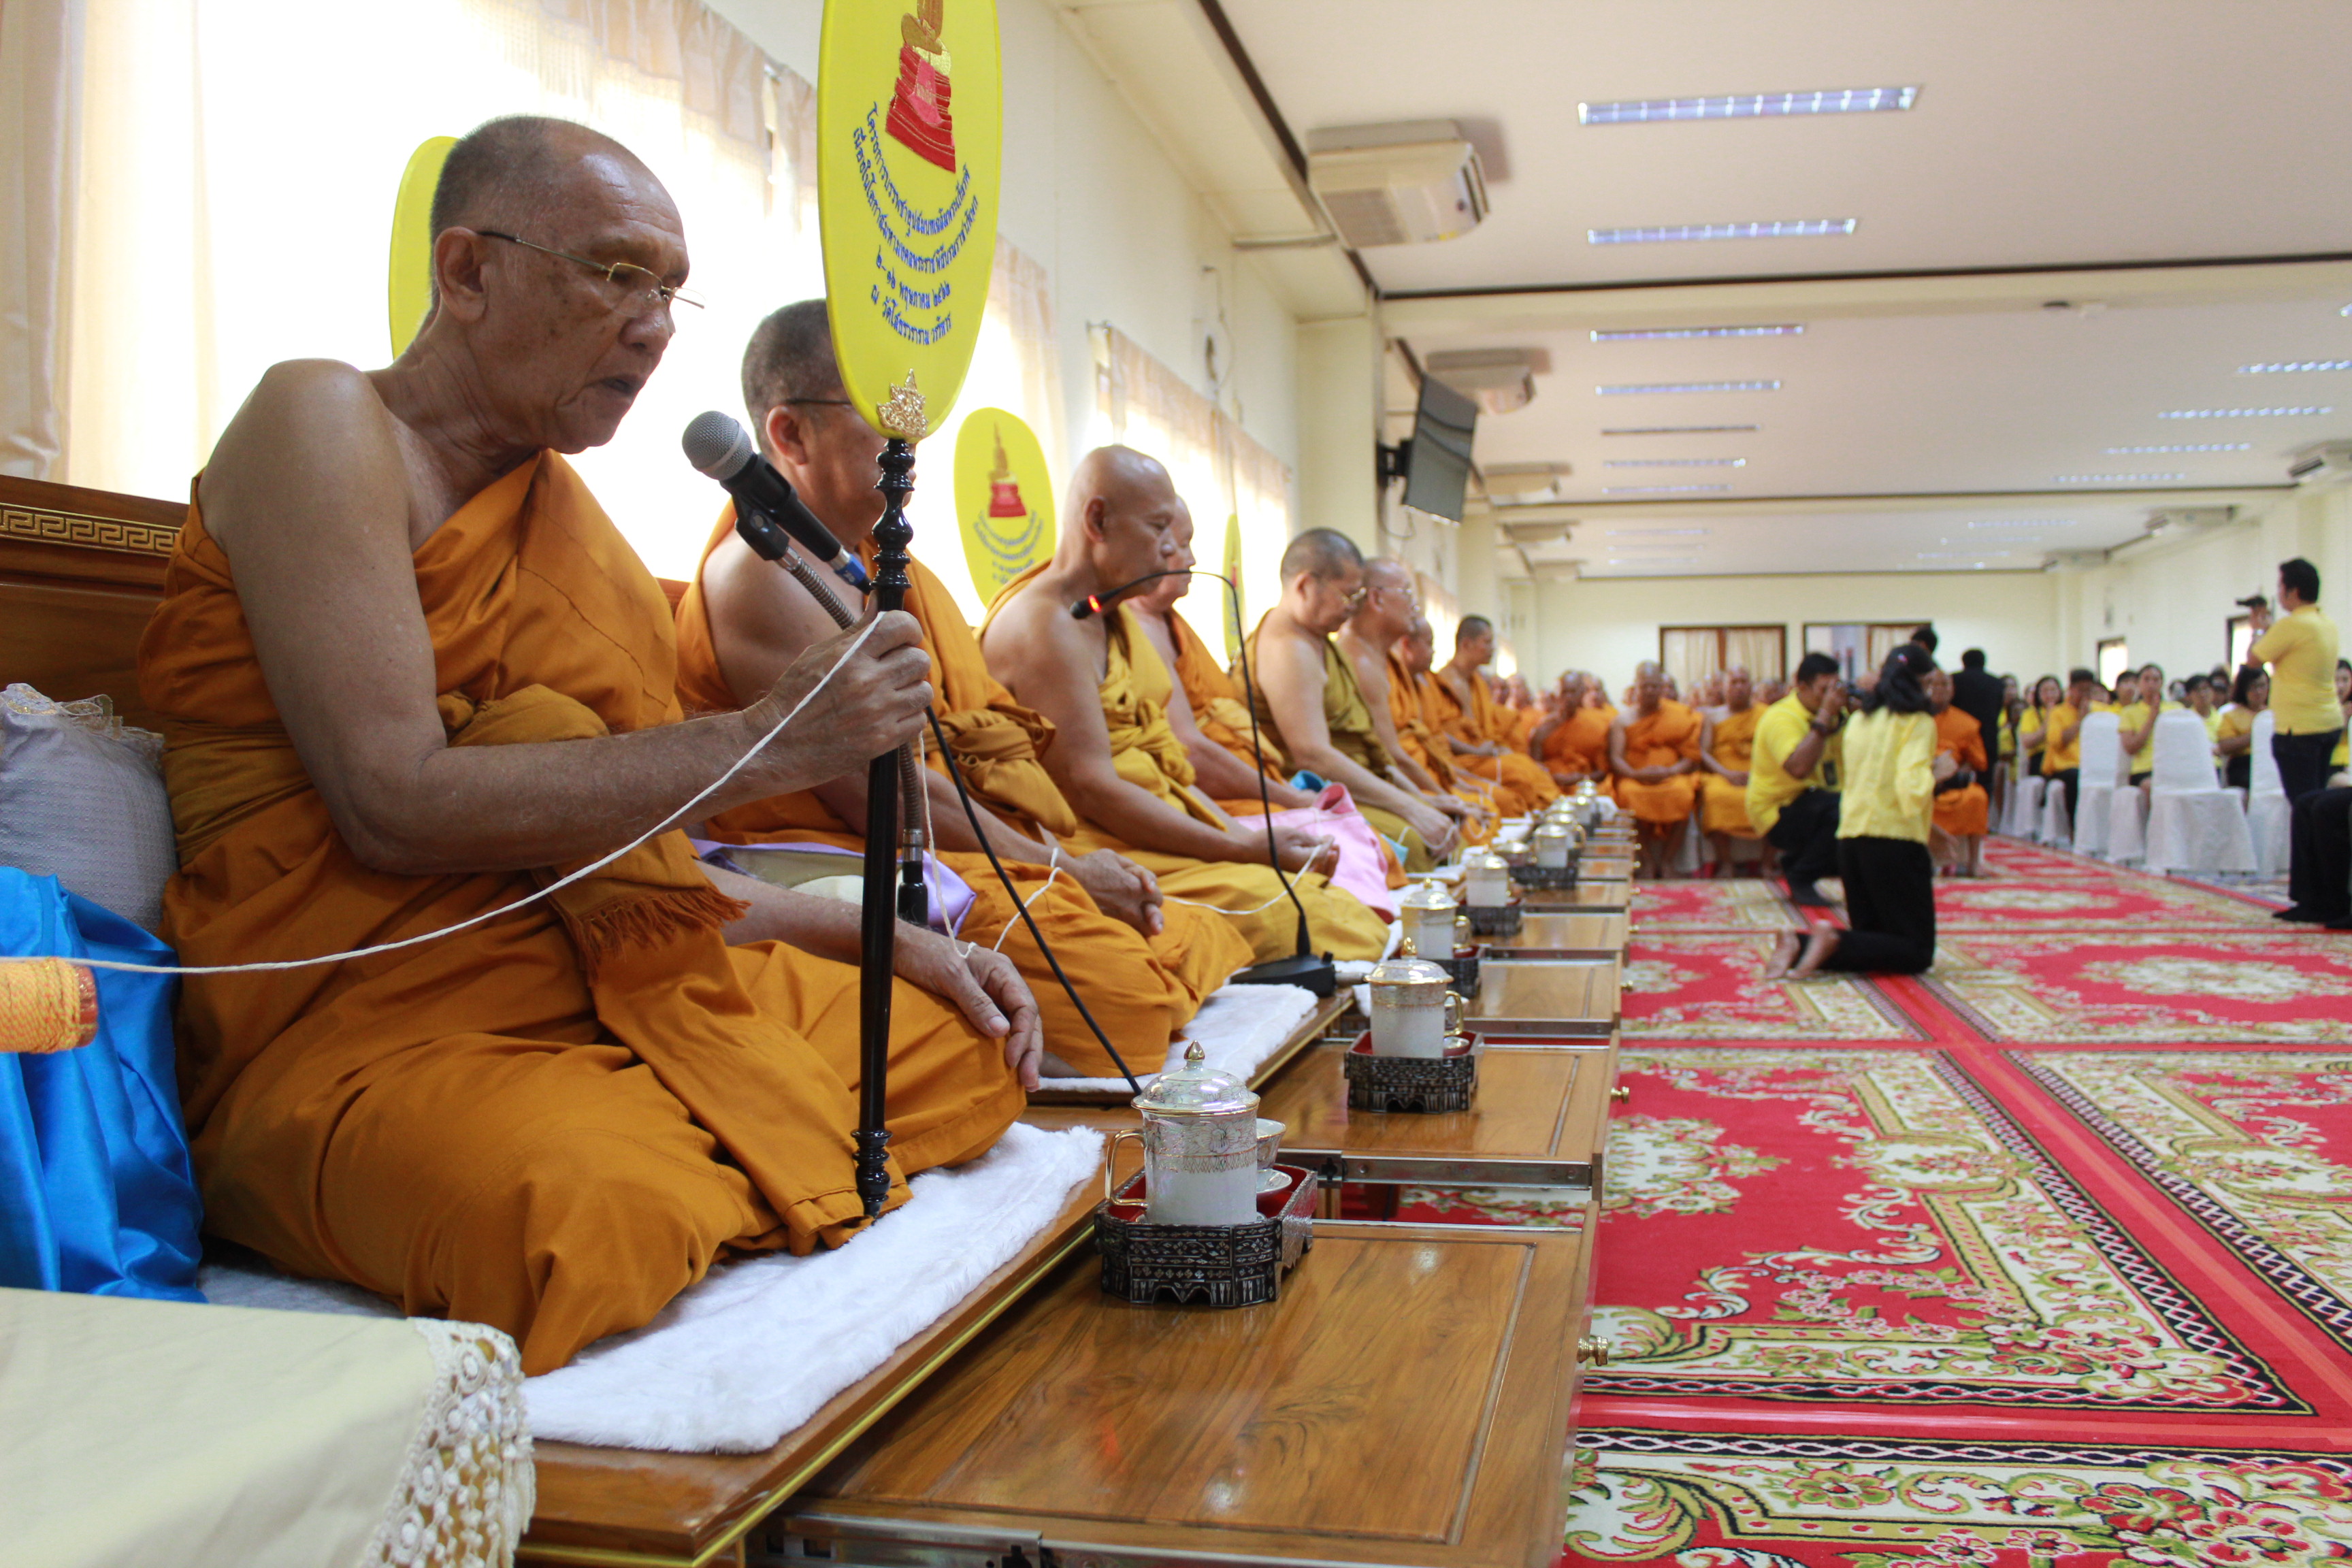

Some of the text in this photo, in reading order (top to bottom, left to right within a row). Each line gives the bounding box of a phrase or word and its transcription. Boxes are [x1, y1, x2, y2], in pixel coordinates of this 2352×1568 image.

[871, 284, 880, 305] ณ
[900, 282, 930, 311] พฤษภาคม
